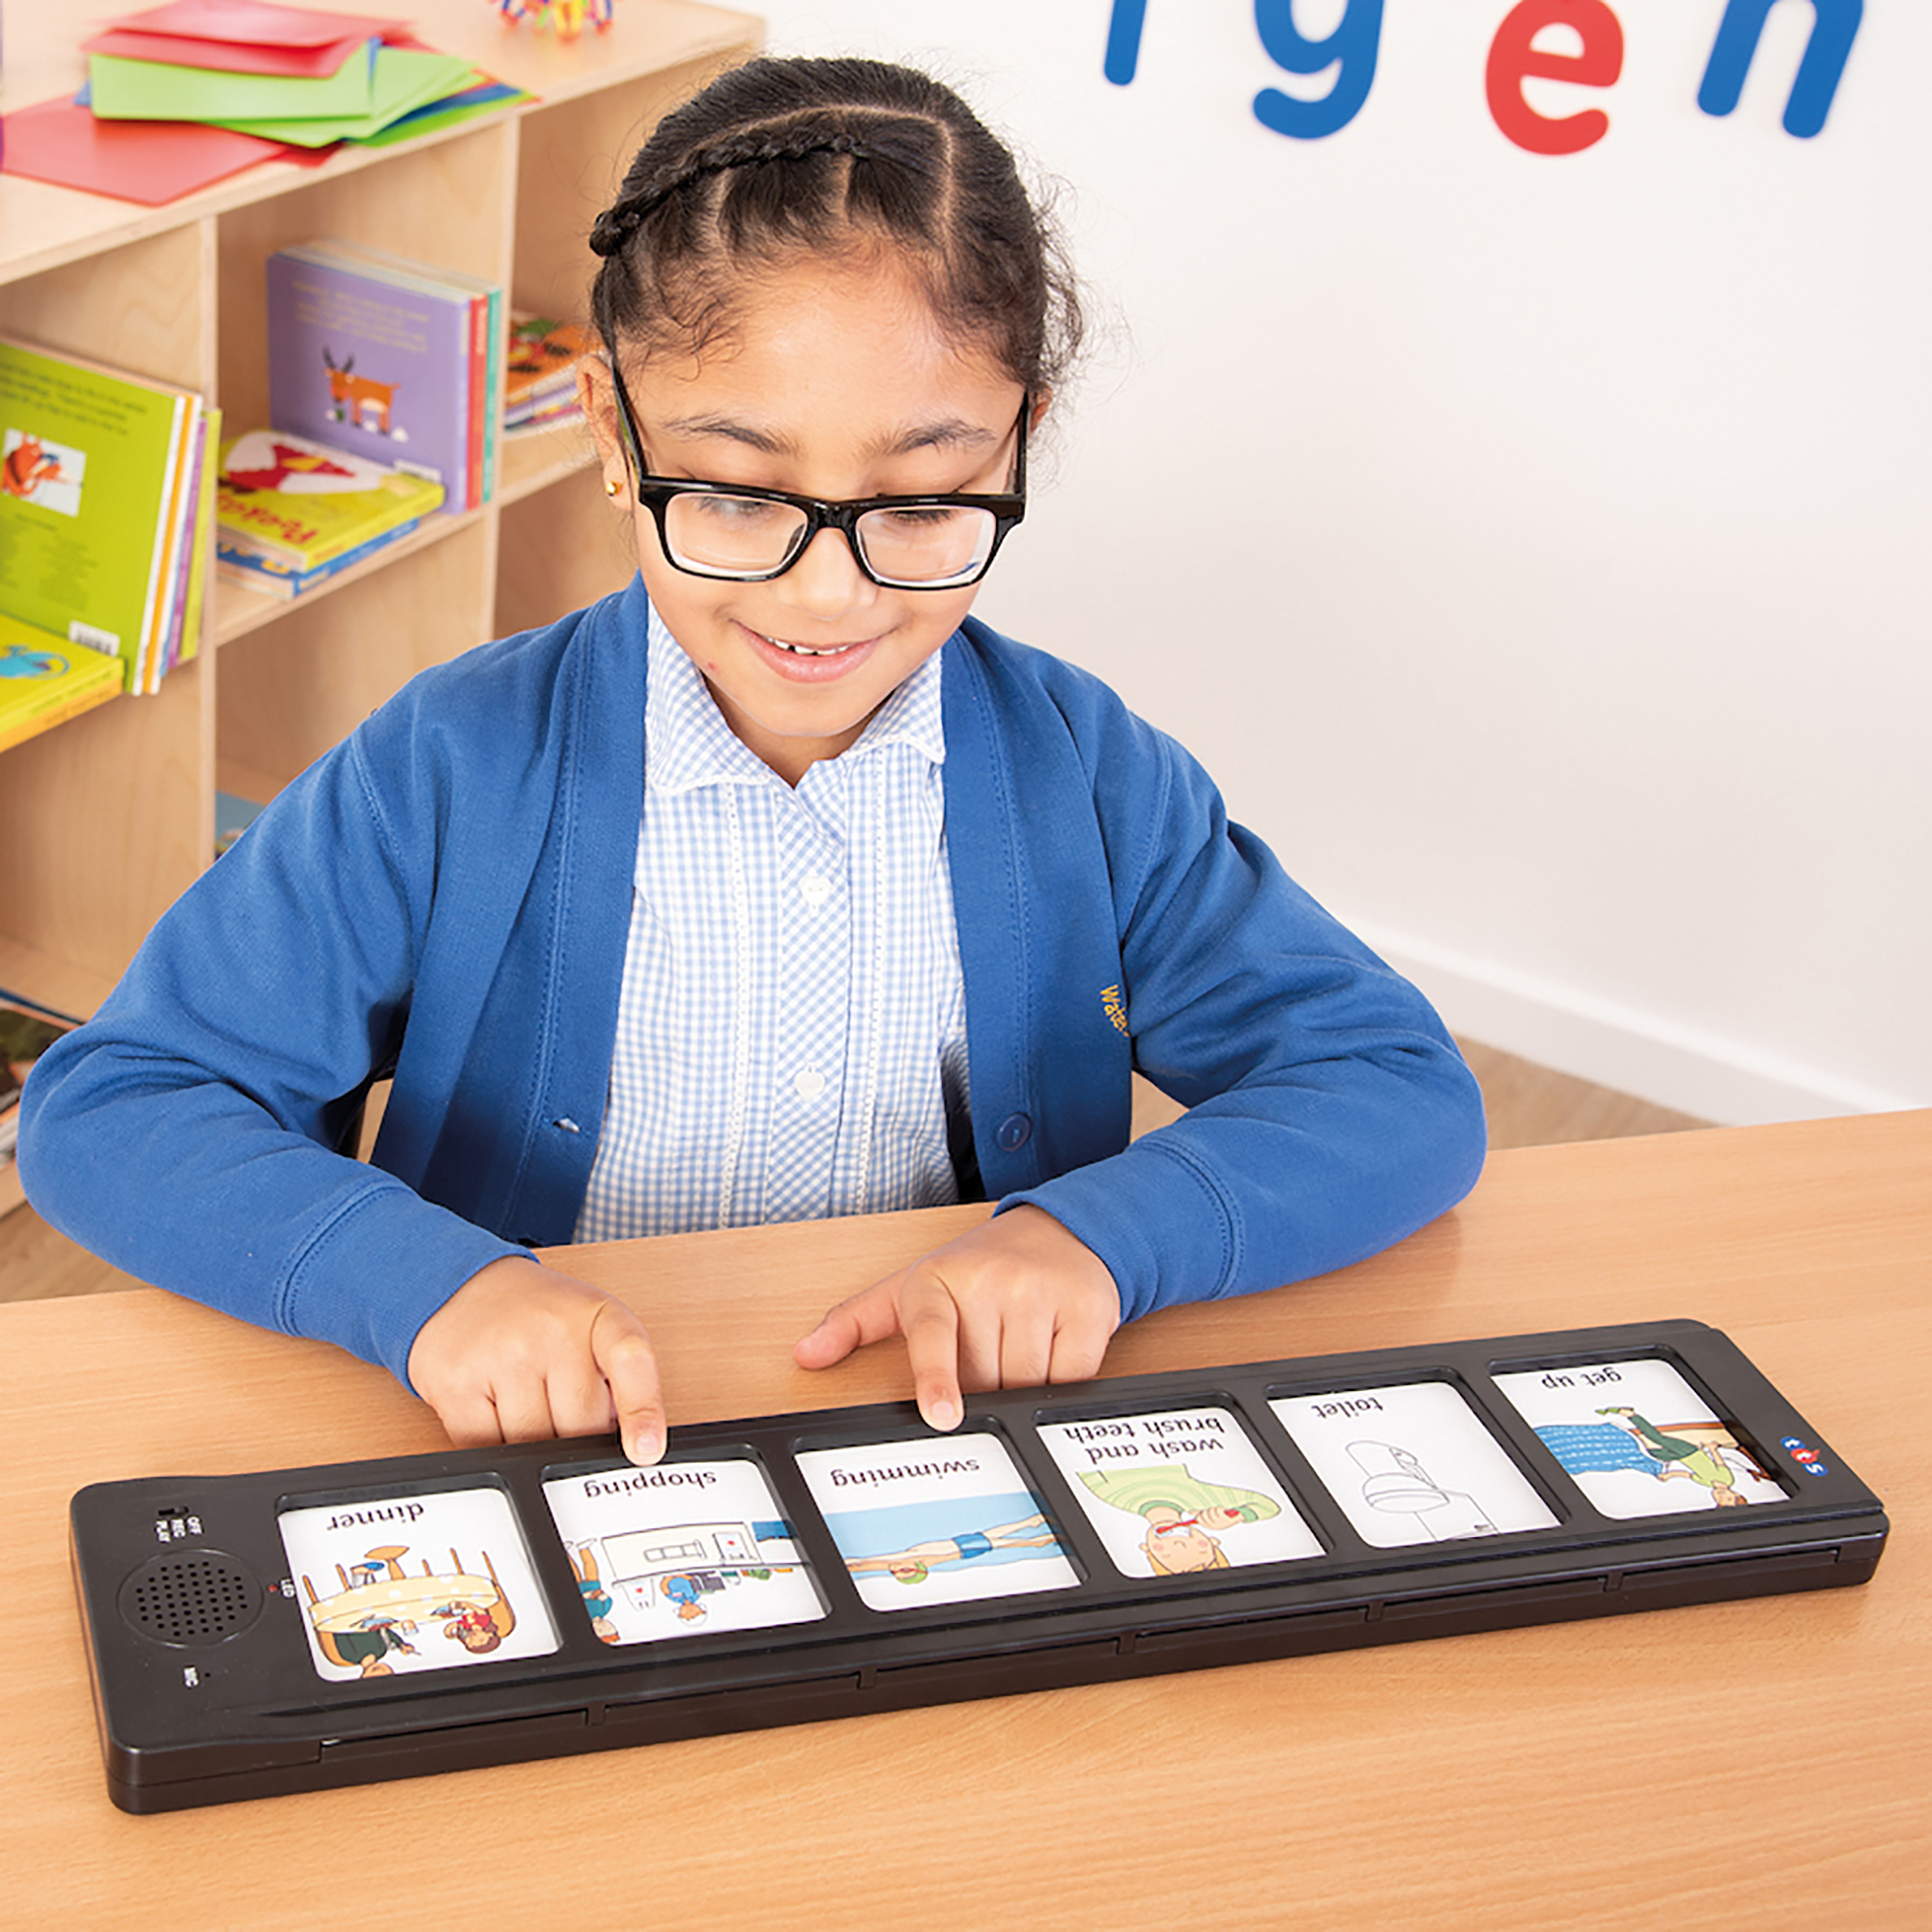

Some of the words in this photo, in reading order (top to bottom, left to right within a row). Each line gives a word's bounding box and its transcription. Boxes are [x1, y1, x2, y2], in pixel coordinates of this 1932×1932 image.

[1542, 1374, 1576, 1389] up
[1579, 1367, 1622, 1386] get
[1311, 1397, 1383, 1419] toilet
[1063, 1422, 1136, 1444] teeth
[1142, 1417, 1226, 1438] brush
[1085, 1443, 1140, 1465] and
[1148, 1437, 1225, 1459] wash
[583, 1470, 717, 1498] shopping
[830, 1459, 980, 1488] swimming
[327, 1503, 424, 1531] dinner
